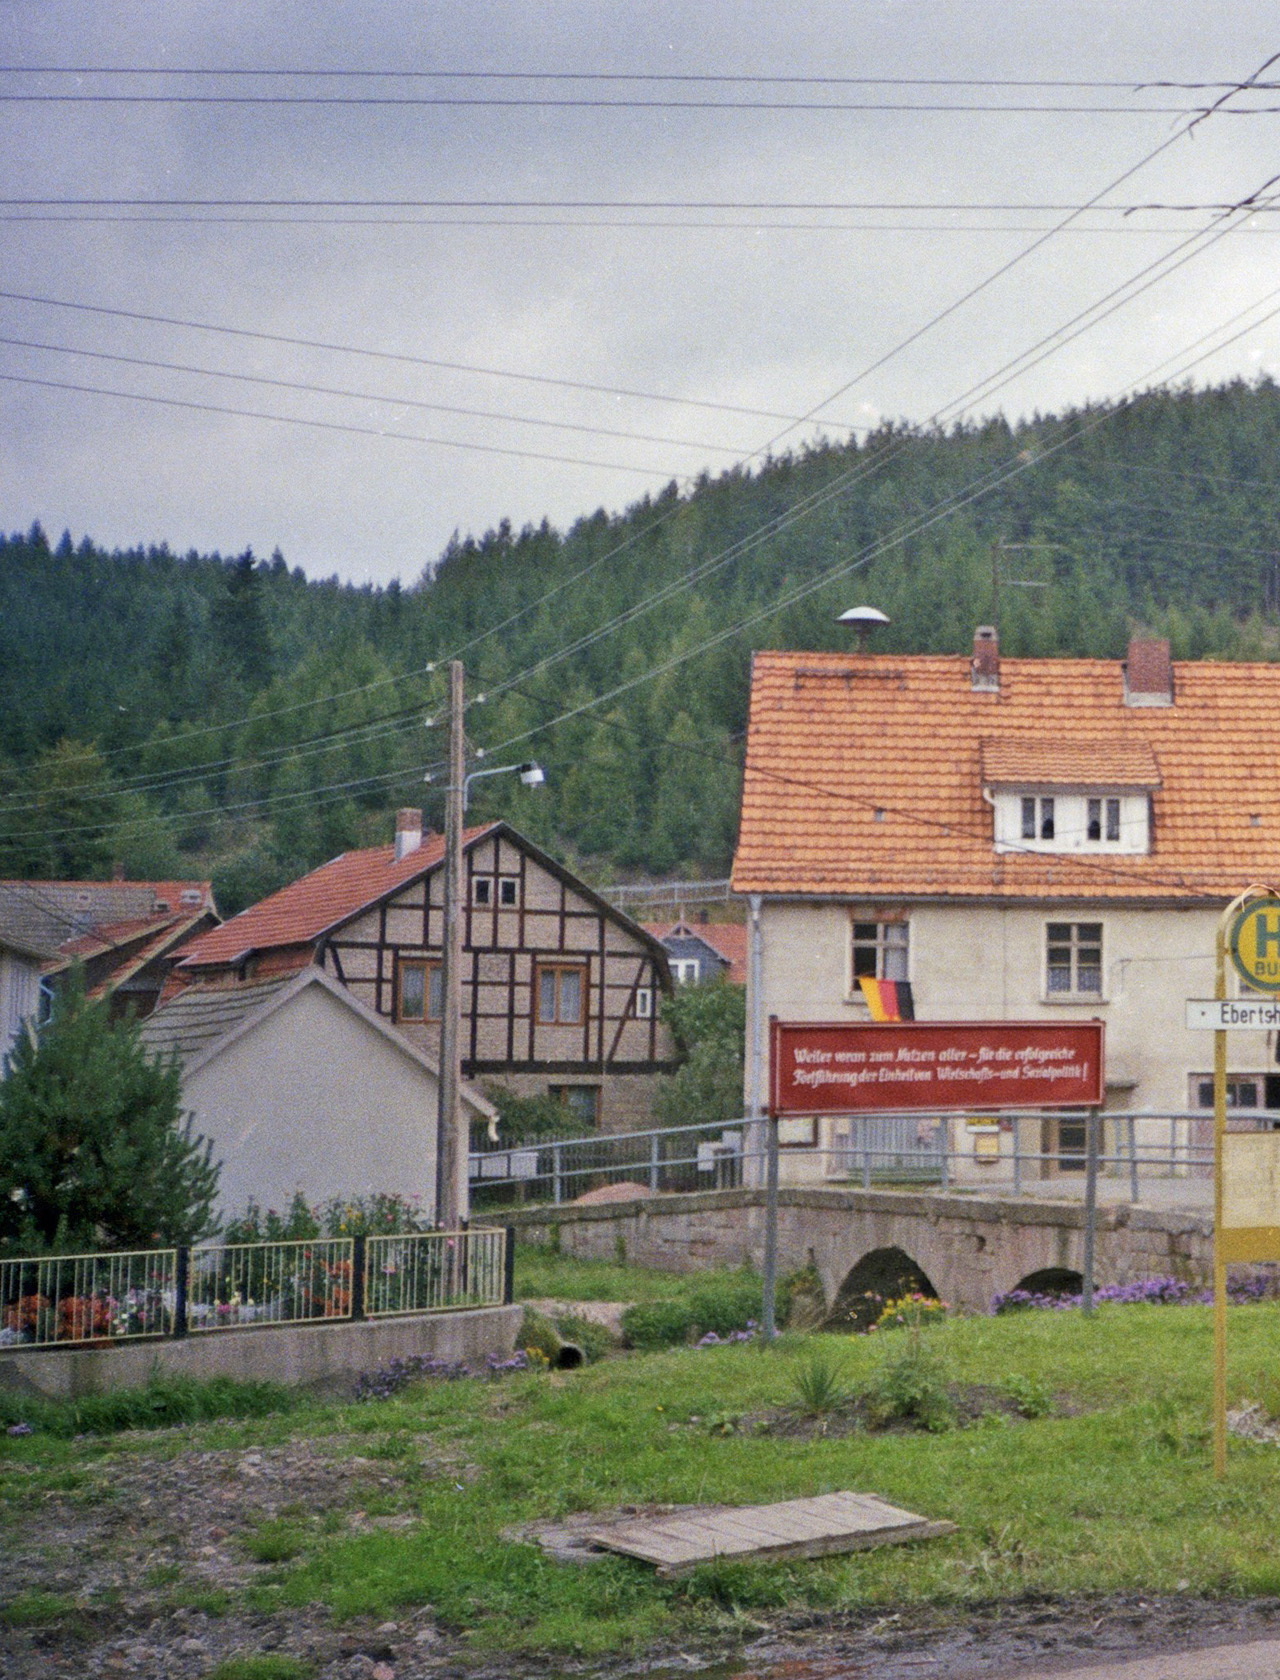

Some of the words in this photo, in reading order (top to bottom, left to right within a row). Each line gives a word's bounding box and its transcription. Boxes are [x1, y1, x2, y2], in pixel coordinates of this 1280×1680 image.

[793, 1047, 832, 1063] Weiter
[868, 1051, 894, 1062] zum
[895, 1047, 935, 1062] Nutzen
[938, 1047, 967, 1061] aller
[977, 1046, 994, 1064] für
[995, 1047, 1013, 1060] die
[1014, 1046, 1076, 1064] erfolgreiche
[858, 1067, 878, 1082] der
